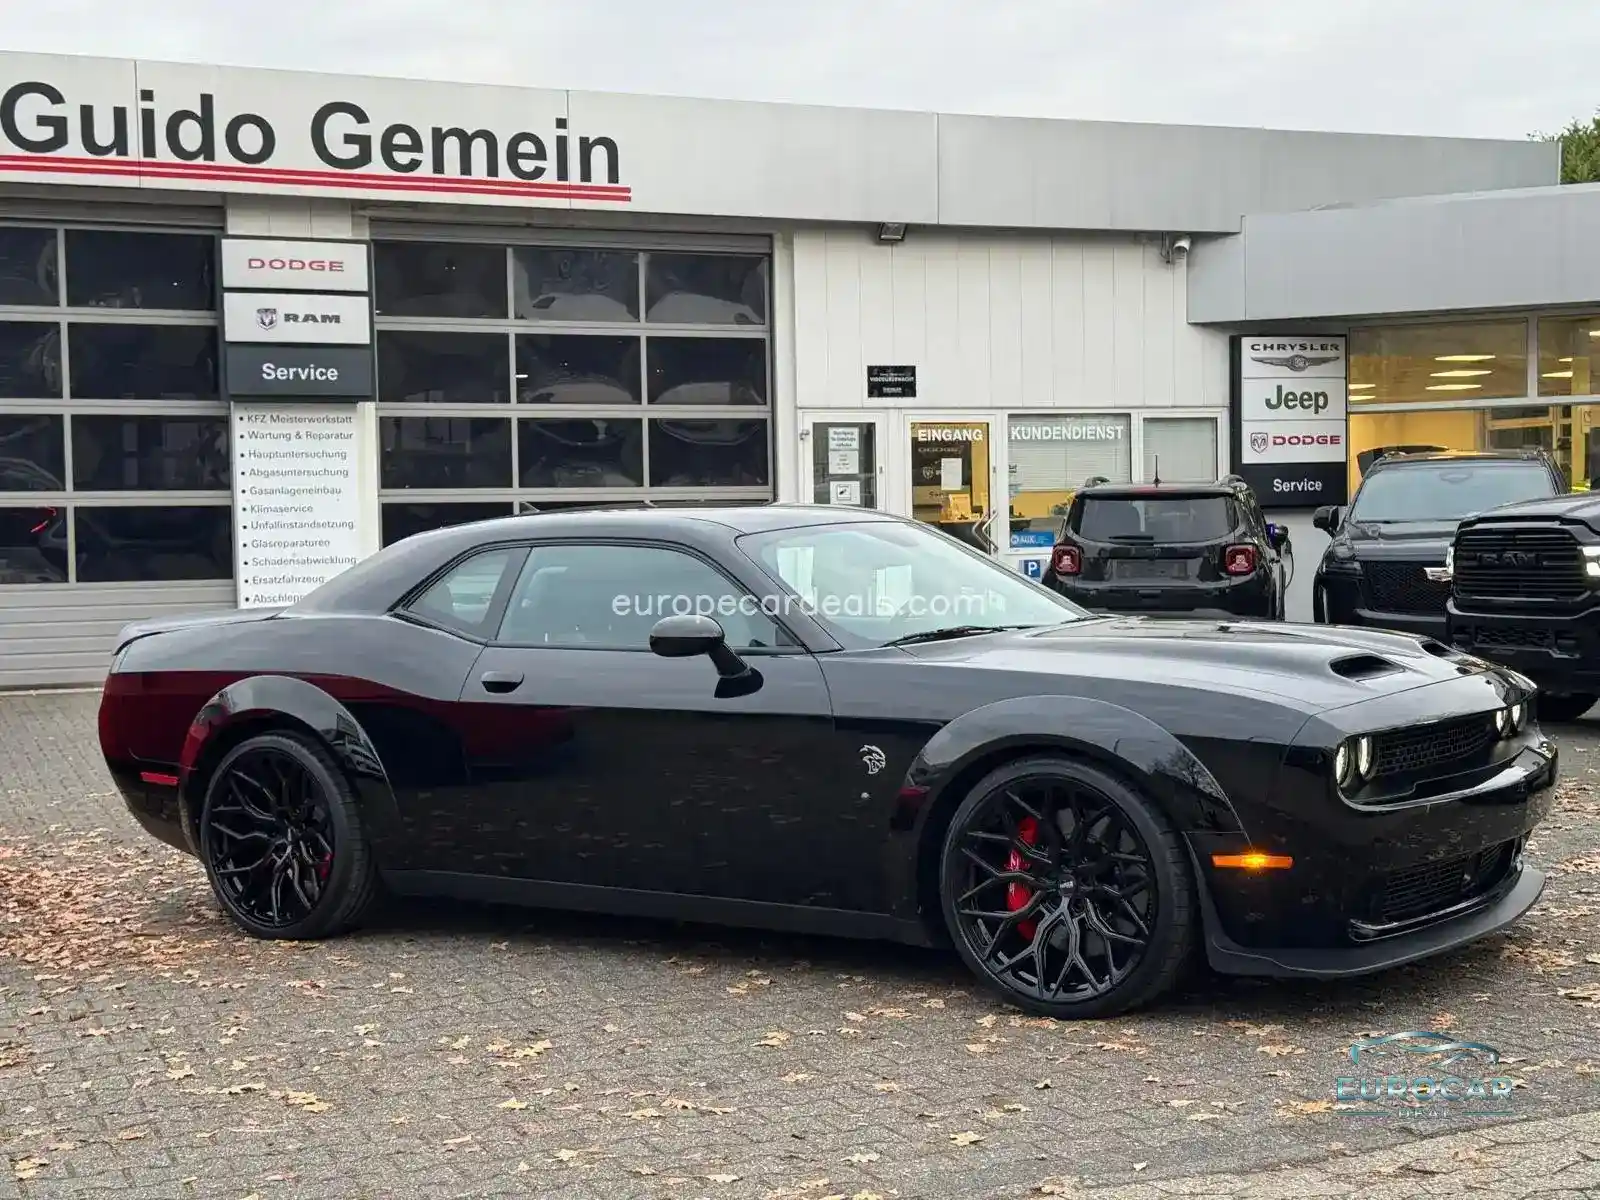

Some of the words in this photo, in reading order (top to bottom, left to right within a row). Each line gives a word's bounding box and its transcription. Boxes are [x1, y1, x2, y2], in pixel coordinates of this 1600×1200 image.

[0, 81, 276, 165] Guido
[310, 101, 619, 185] Gemein
[248, 258, 345, 272] DODGE
[284, 313, 341, 324] RAM
[1250, 343, 1340, 352] CHRYSLER
[262, 362, 339, 381] Service
[1264, 384, 1329, 414] Jeep
[247, 415, 266, 423] KFZ
[270, 415, 353, 424] Meisterwerkstatt
[248, 431, 291, 441] Wartung
[295, 431, 302, 440] &
[305, 431, 354, 441] Reparatur
[917, 428, 984, 441] EINGANG
[1011, 425, 1124, 440] KUNDENDIENST
[1272, 435, 1341, 445] DODGE
[248, 450, 347, 460] Hauptuntersuchung
[249, 468, 349, 478] Abgasuntersuchung
[1273, 478, 1323, 492] Service
[249, 486, 342, 496] Gasanlageneinbau
[250, 504, 313, 513] Klimaservice
[250, 521, 354, 530] Unfallinstandsetzung
[251, 539, 330, 548] Glasreparaturen
[251, 556, 357, 567] Schadensabwicklung
[1028, 561, 1038, 575] P
